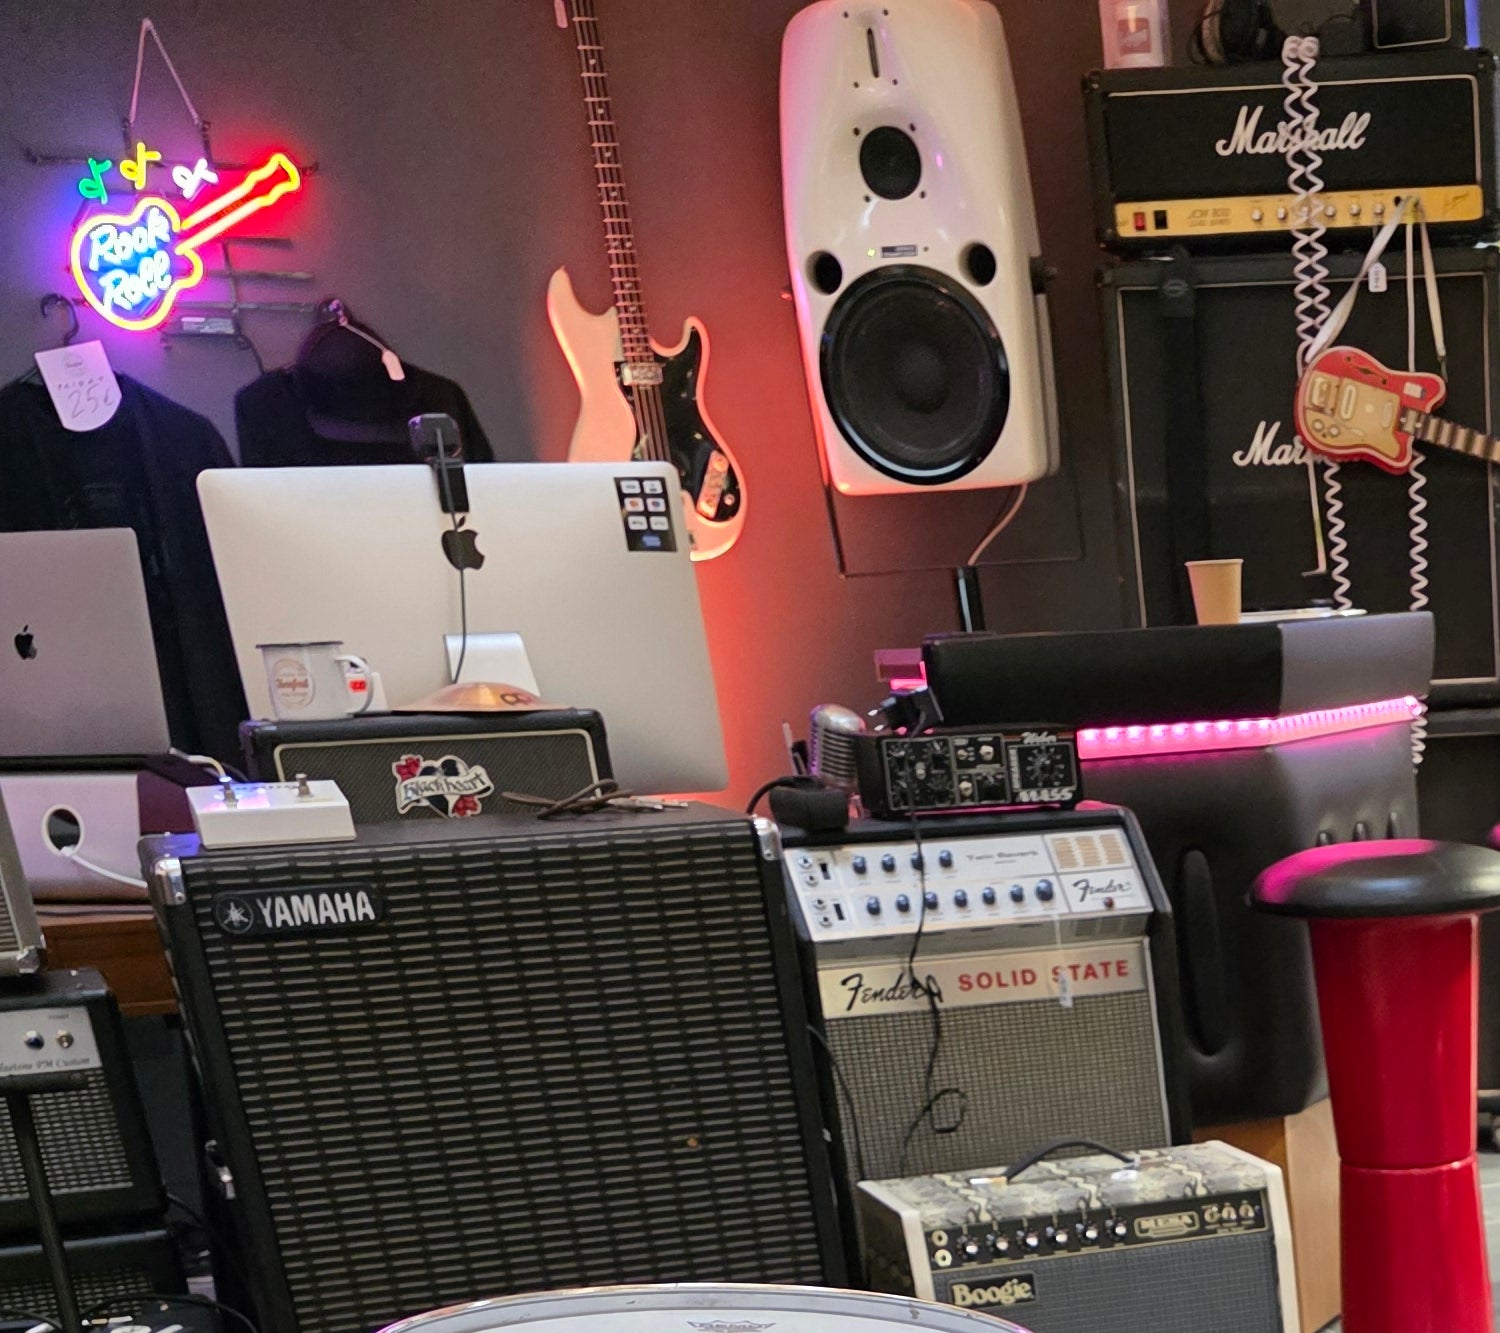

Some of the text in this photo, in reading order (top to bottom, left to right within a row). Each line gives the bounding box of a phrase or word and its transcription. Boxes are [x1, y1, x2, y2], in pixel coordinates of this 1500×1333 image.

[256, 891, 375, 928] YAMAHA
[841, 973, 943, 1011] Fender
[958, 960, 1129, 992] SOLID STATE
[951, 1278, 1033, 1306] Boogie
